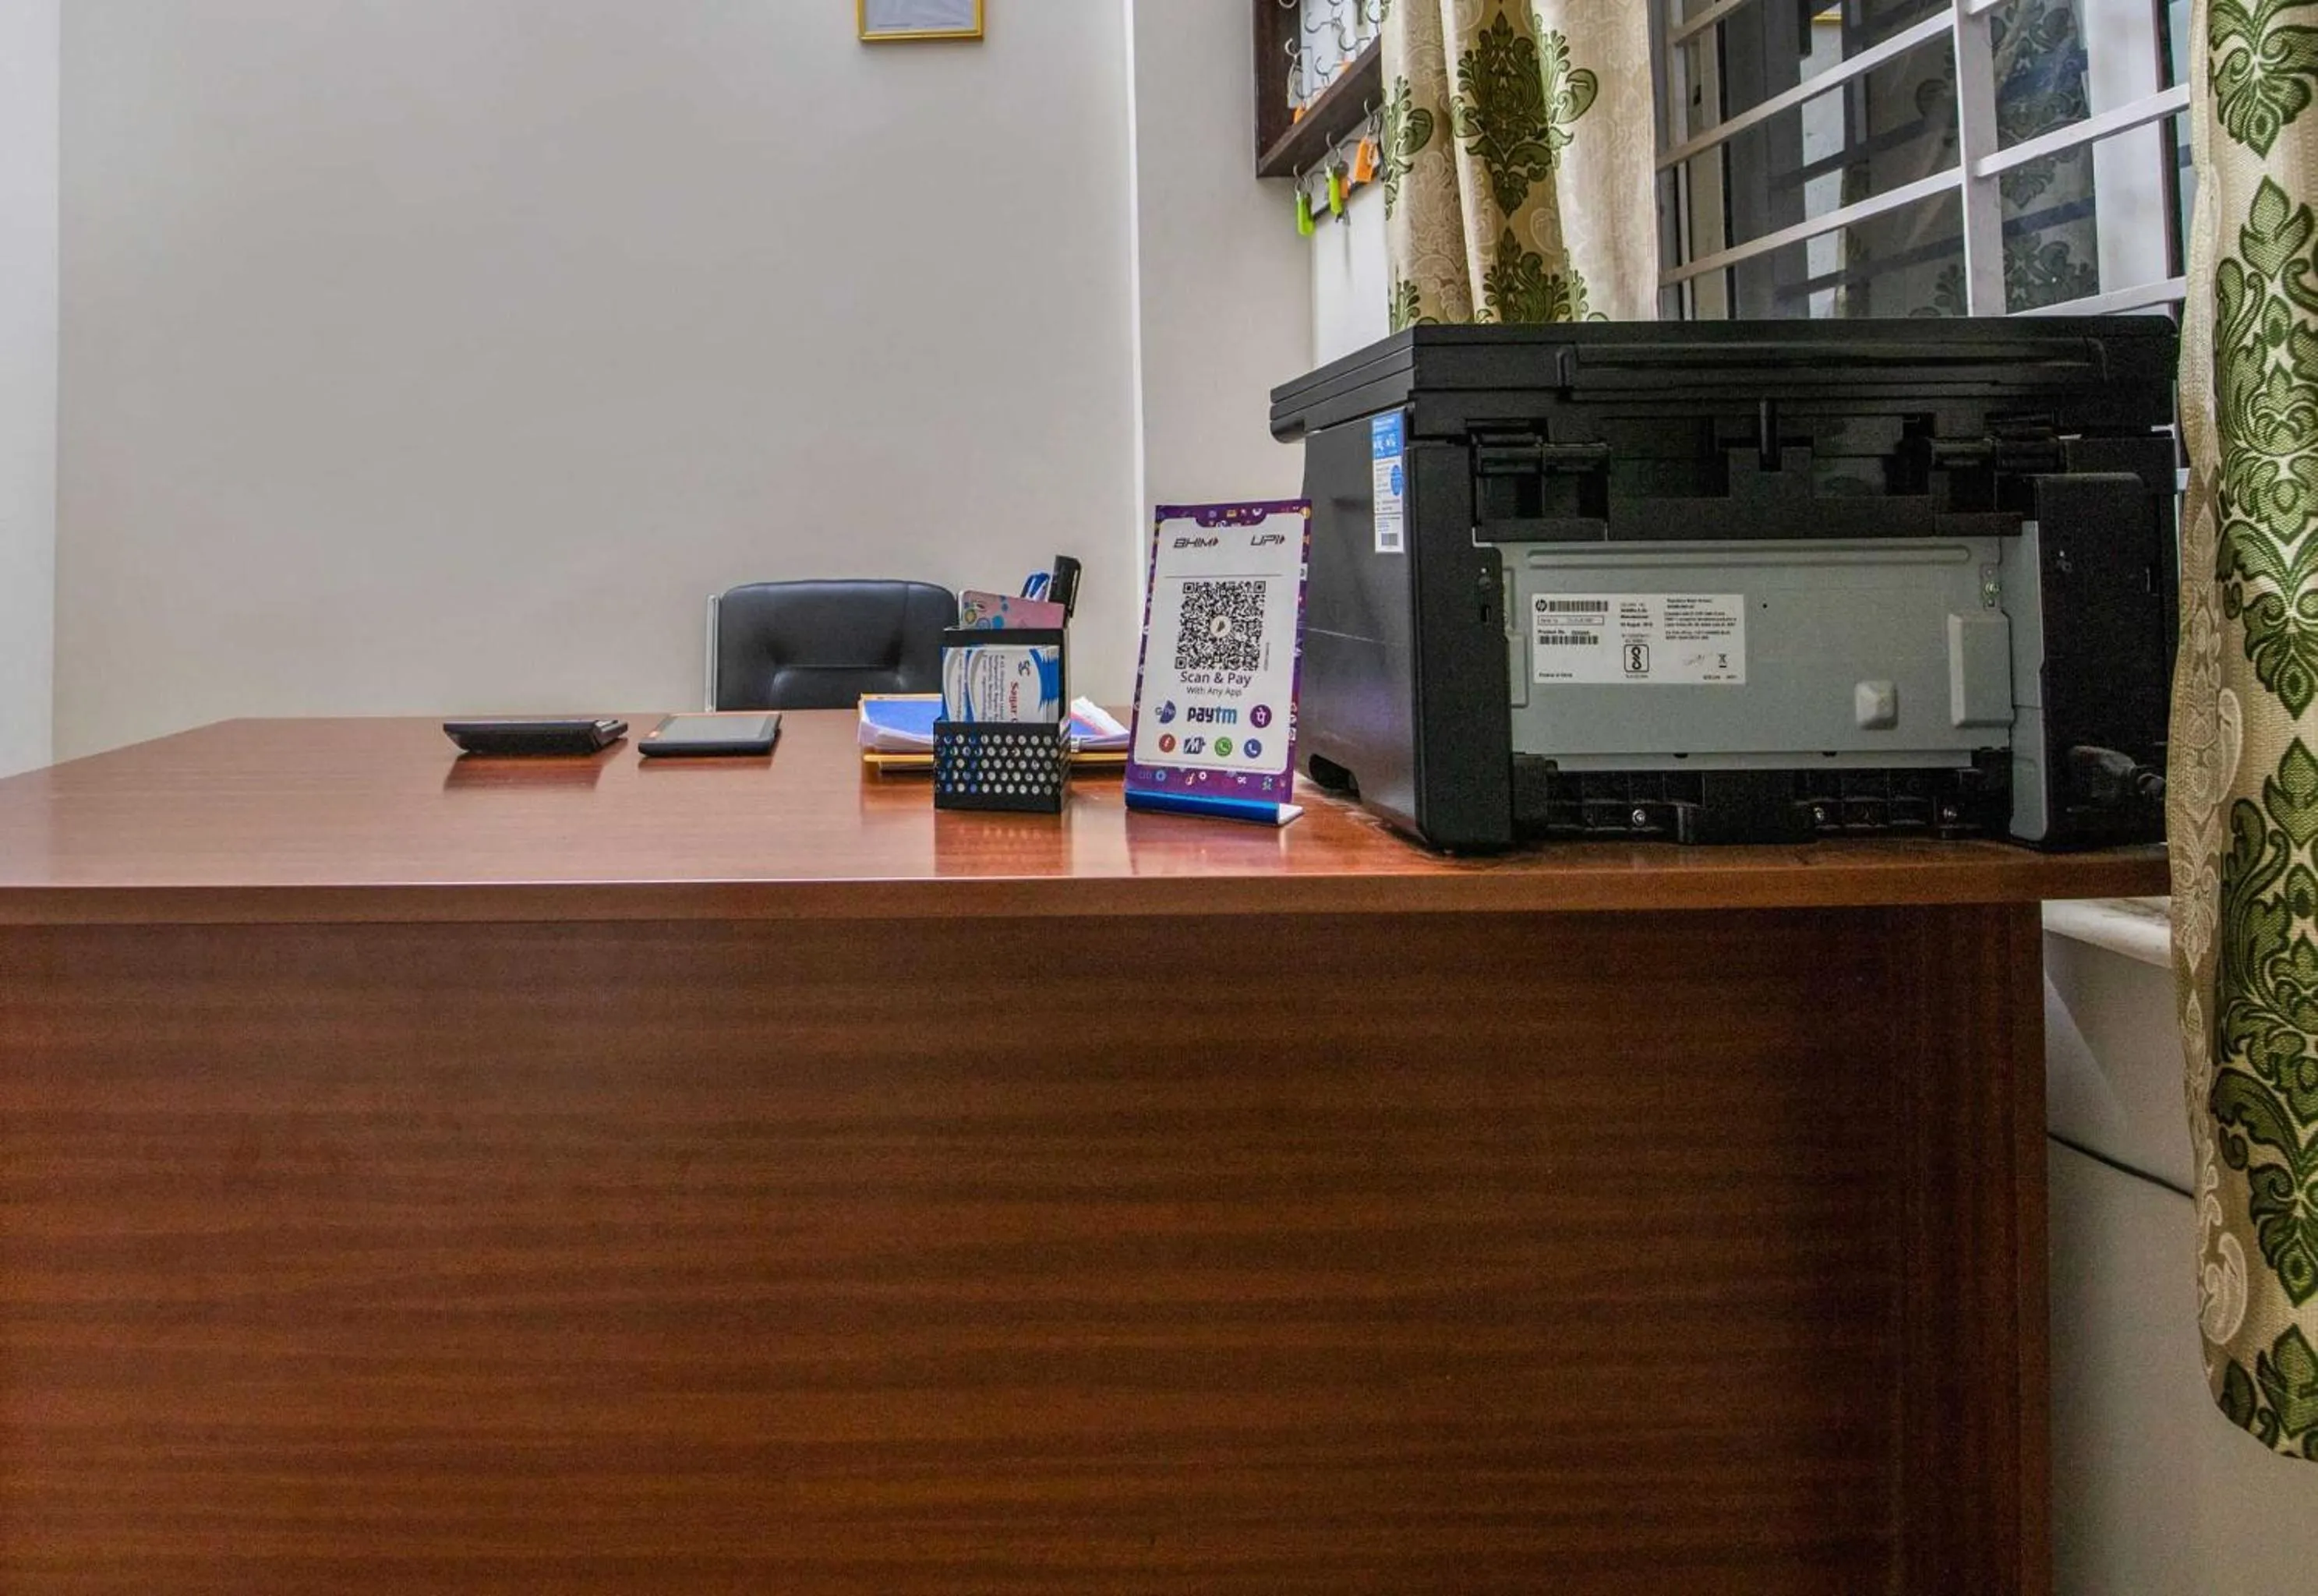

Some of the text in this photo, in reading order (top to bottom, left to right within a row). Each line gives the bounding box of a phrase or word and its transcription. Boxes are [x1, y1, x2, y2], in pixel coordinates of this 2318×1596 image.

[1174, 538, 1214, 549] BHIM
[1180, 672, 1252, 687] Scan & Pay
[1009, 681, 1019, 714] Sagar
[1207, 687, 1223, 696] Any
[1187, 706, 1238, 724] paytm
